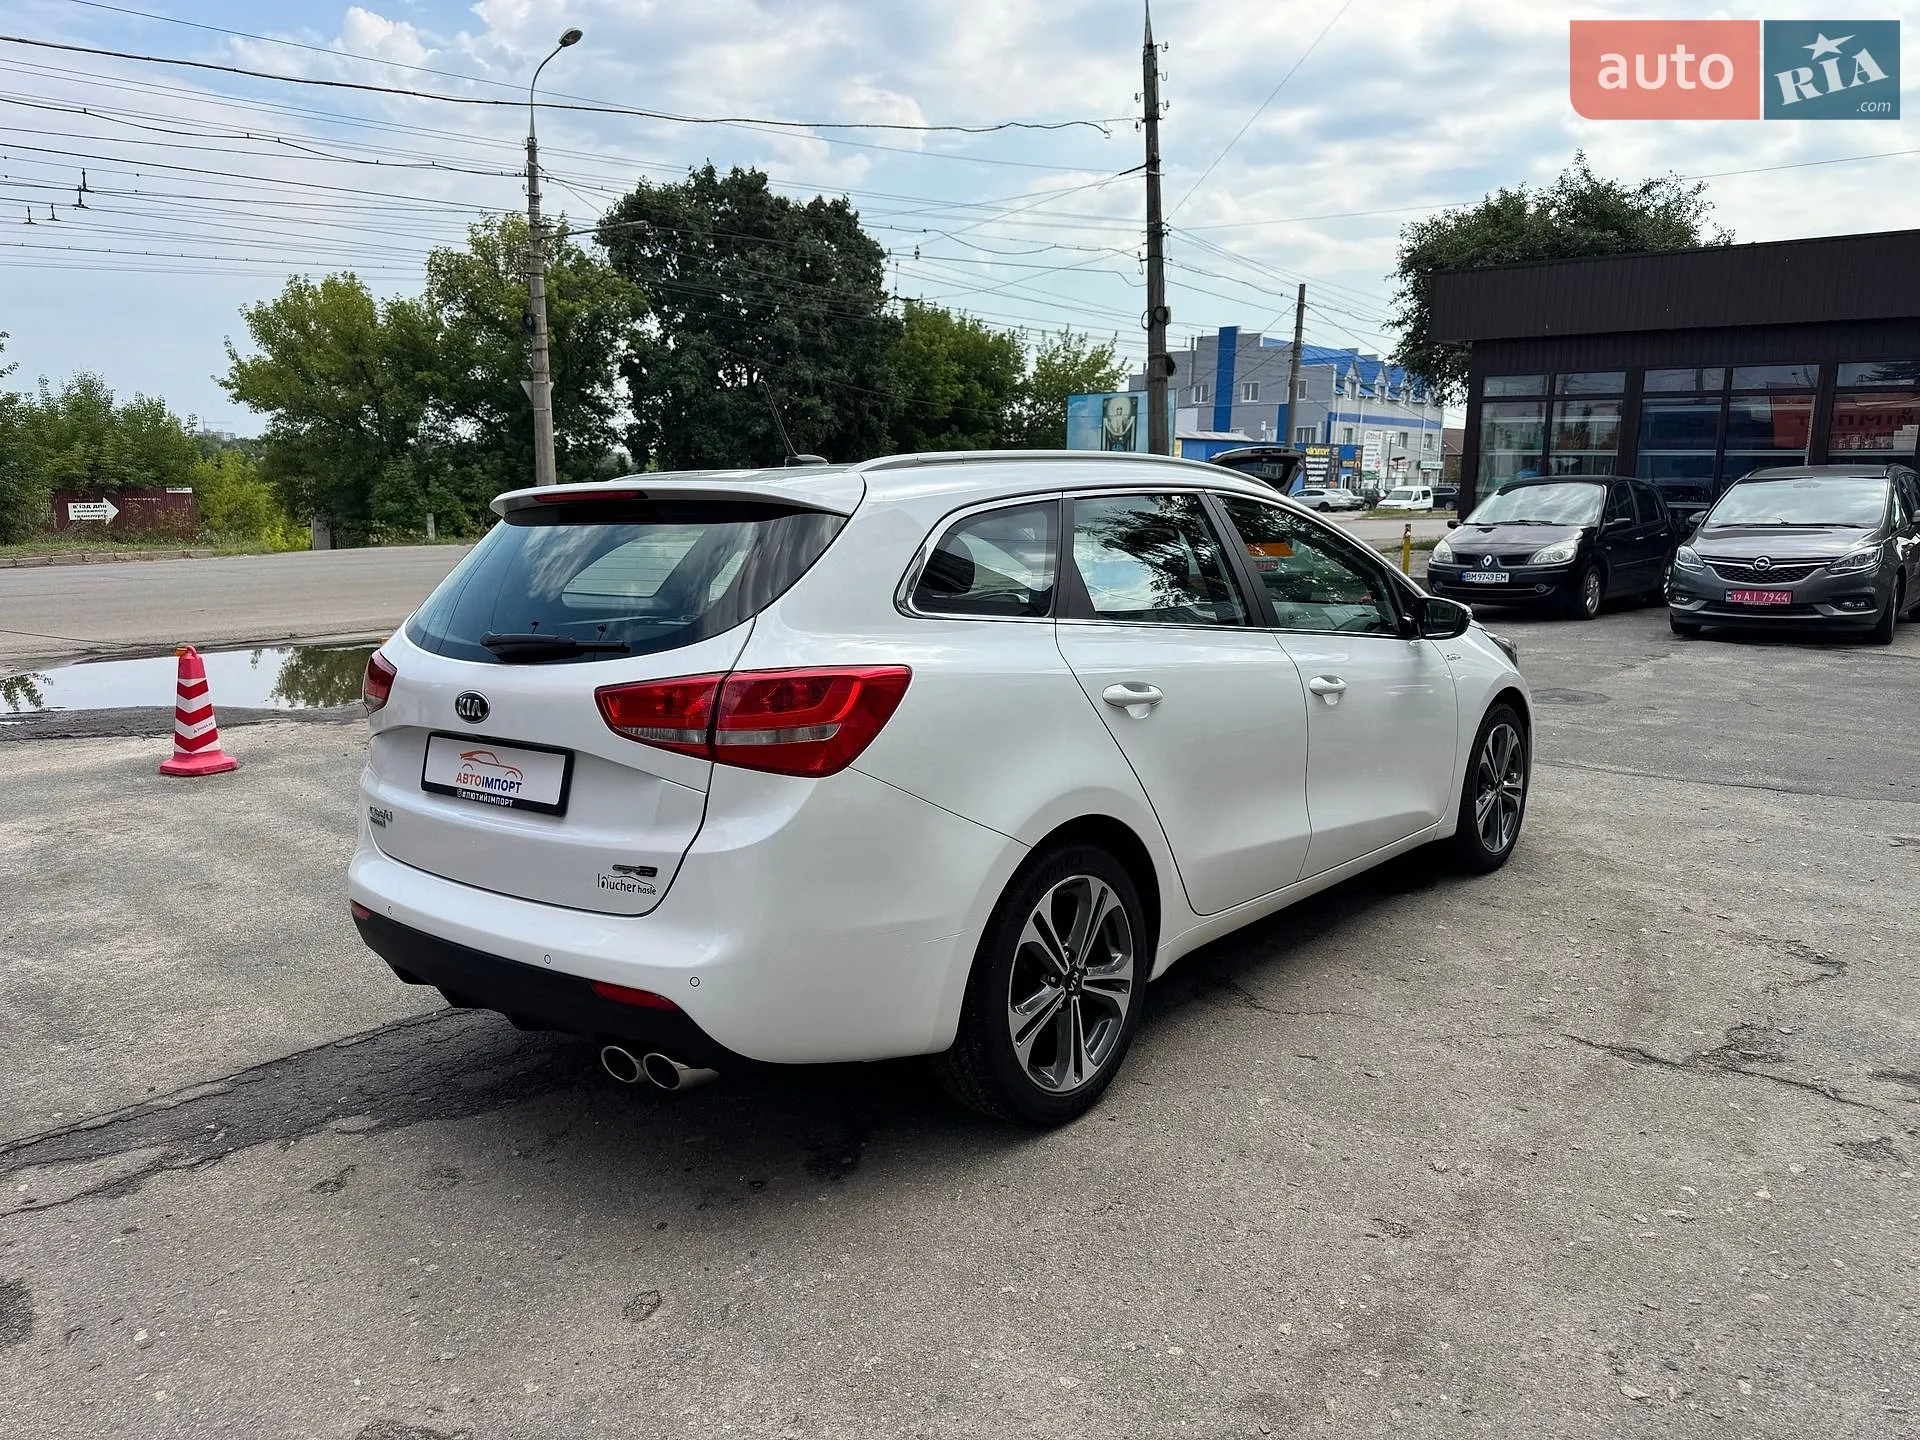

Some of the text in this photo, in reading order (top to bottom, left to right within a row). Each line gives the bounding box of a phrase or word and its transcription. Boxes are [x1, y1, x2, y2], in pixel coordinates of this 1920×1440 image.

[1762, 592, 1788, 602] 7944
[458, 698, 482, 717] KIA
[456, 772, 523, 794] АВТОІМПОРТ
[1068, 972, 1080, 992] KIA
